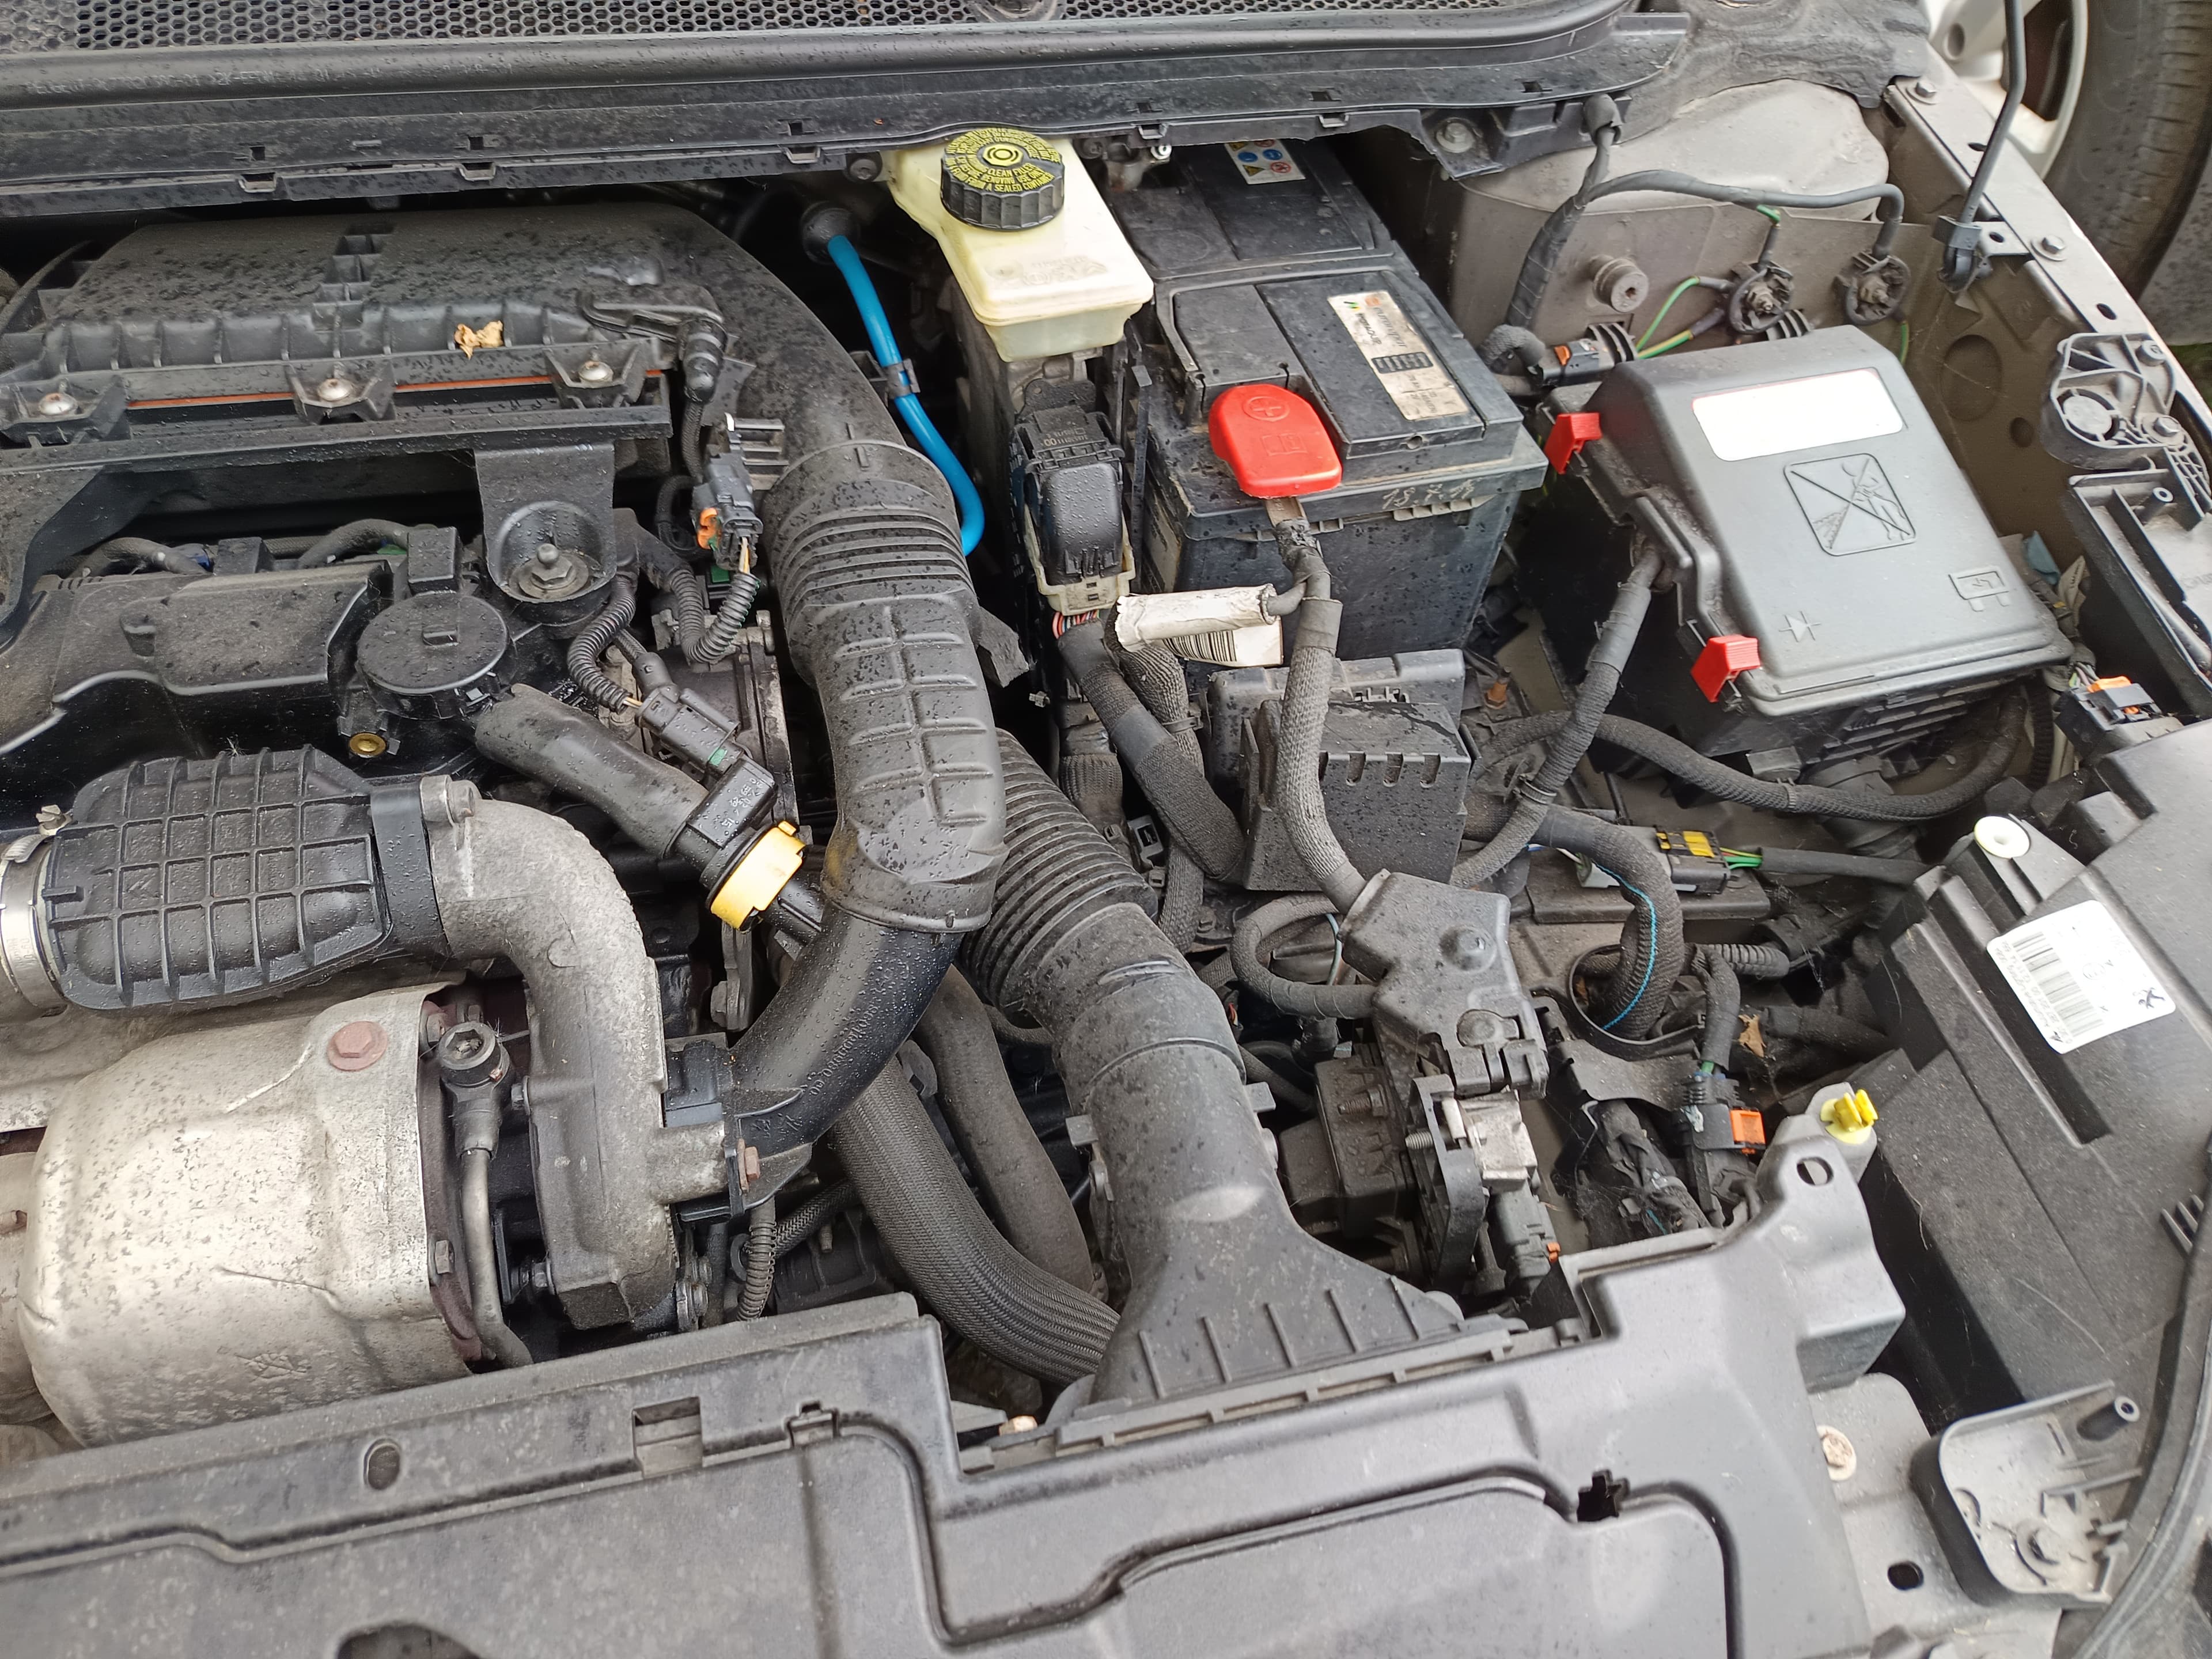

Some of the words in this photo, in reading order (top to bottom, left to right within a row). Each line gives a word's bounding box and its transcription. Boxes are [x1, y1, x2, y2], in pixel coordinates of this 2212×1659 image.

[987, 168, 1013, 177] CLEAN
[1012, 163, 1036, 176] FILLER
[1016, 174, 1030, 183] USE
[985, 183, 993, 191] A
[994, 184, 1023, 193] SEALED
